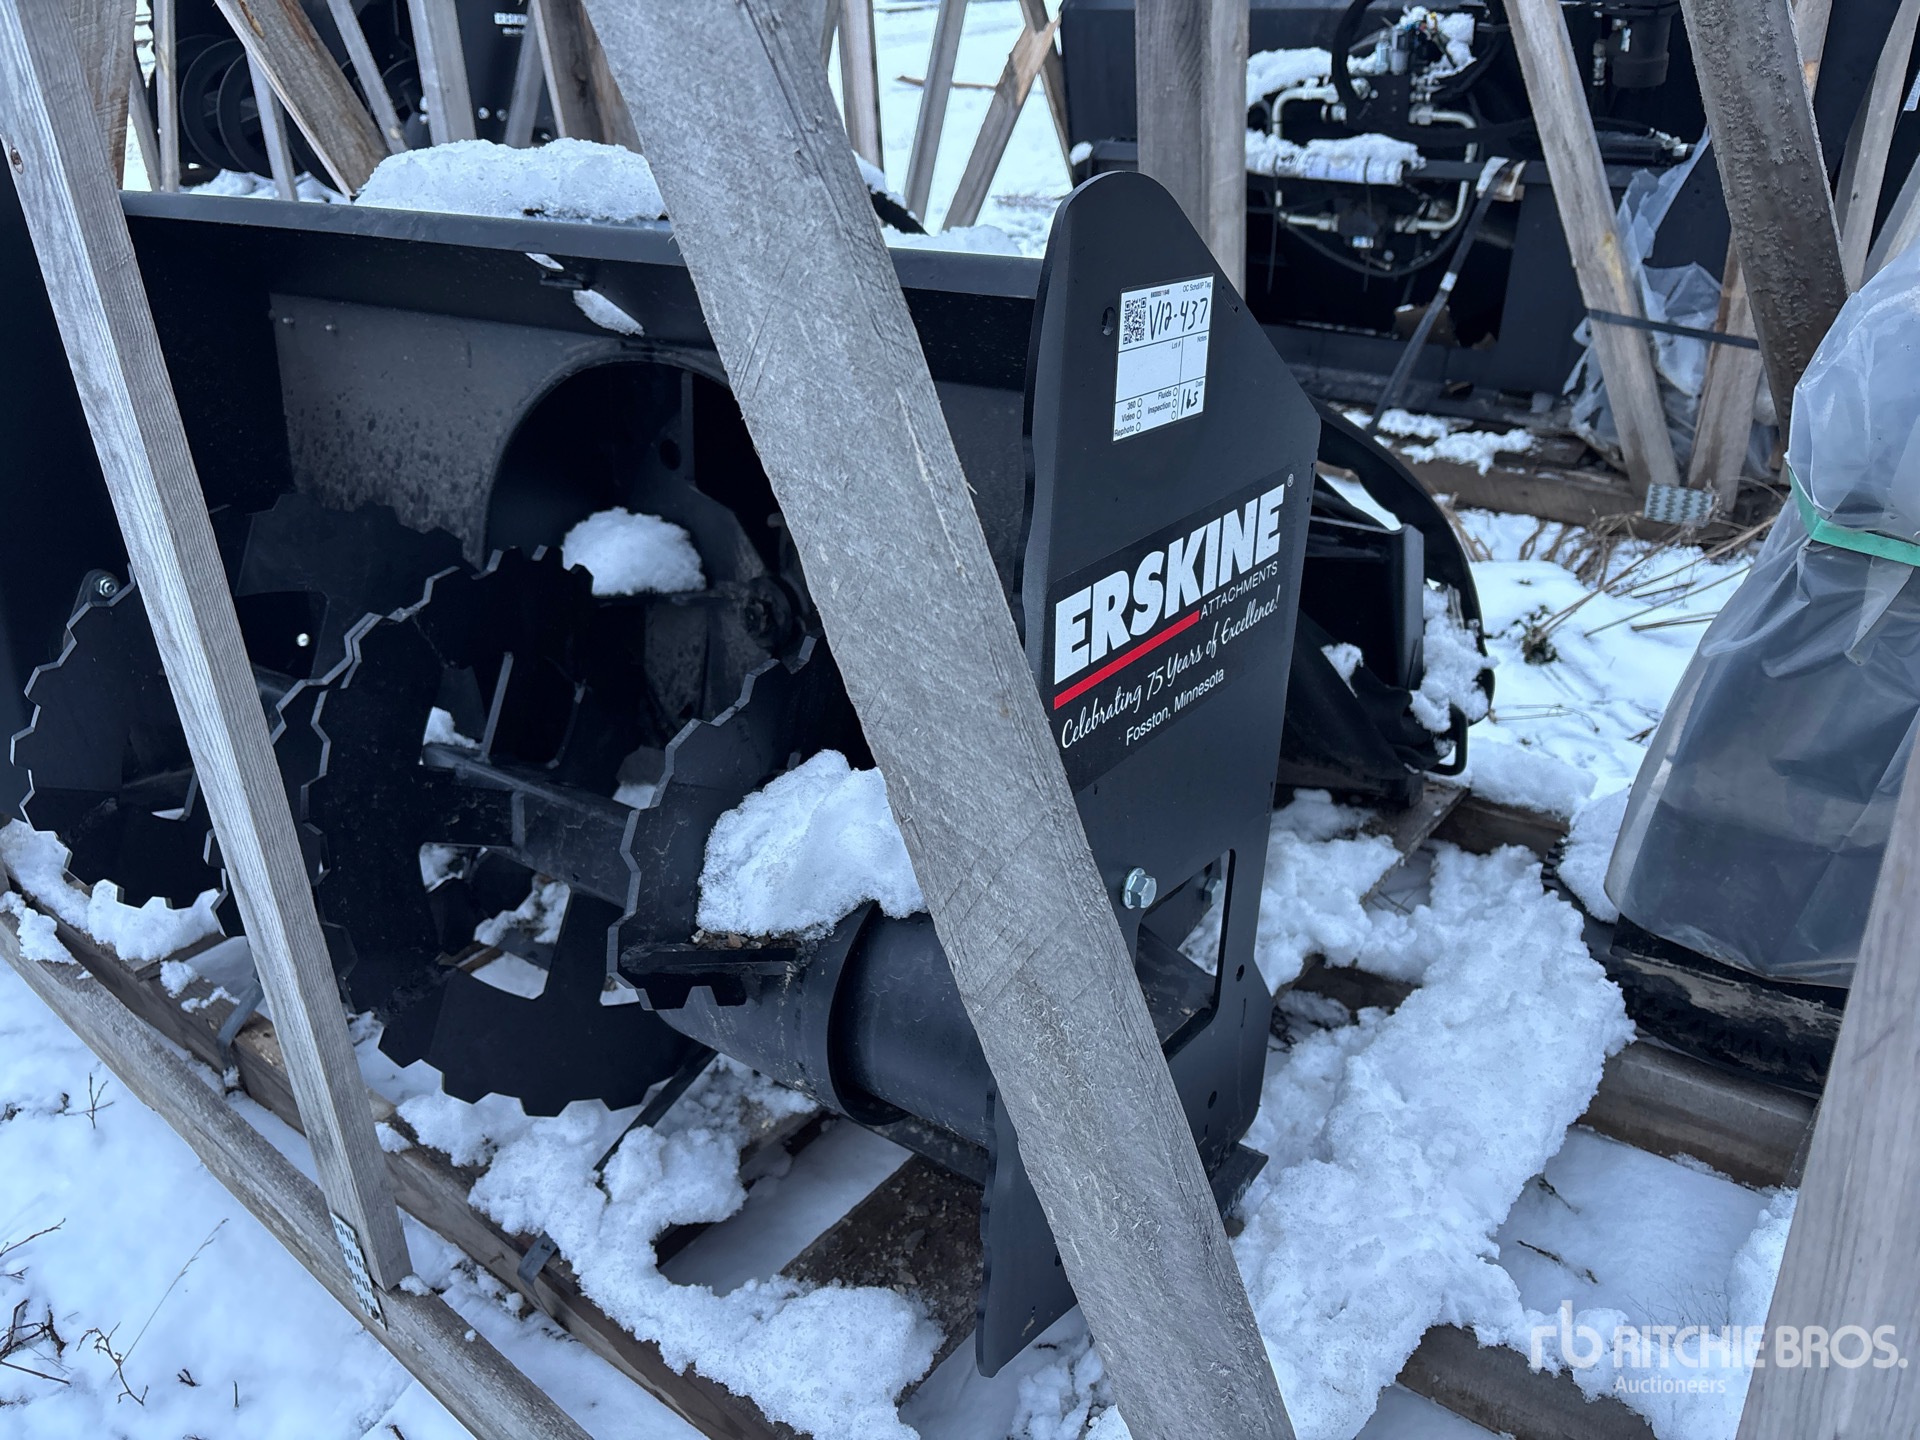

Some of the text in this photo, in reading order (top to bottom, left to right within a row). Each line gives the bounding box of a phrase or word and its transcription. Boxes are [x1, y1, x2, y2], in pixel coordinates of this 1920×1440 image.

[1158, 390, 1172, 400] Fluids
[1127, 400, 1137, 411] 360
[1148, 401, 1172, 415] Inspection
[1122, 412, 1136, 423] Video
[1114, 425, 1135, 437] Rephoto
[1054, 483, 1285, 686] ERSKINE
[1200, 560, 1278, 620] ATTACHMENTS
[1061, 585, 1281, 749] Celebrating 75 Years of Excellence!
[1126, 667, 1225, 746] Fosston, Minnesota
